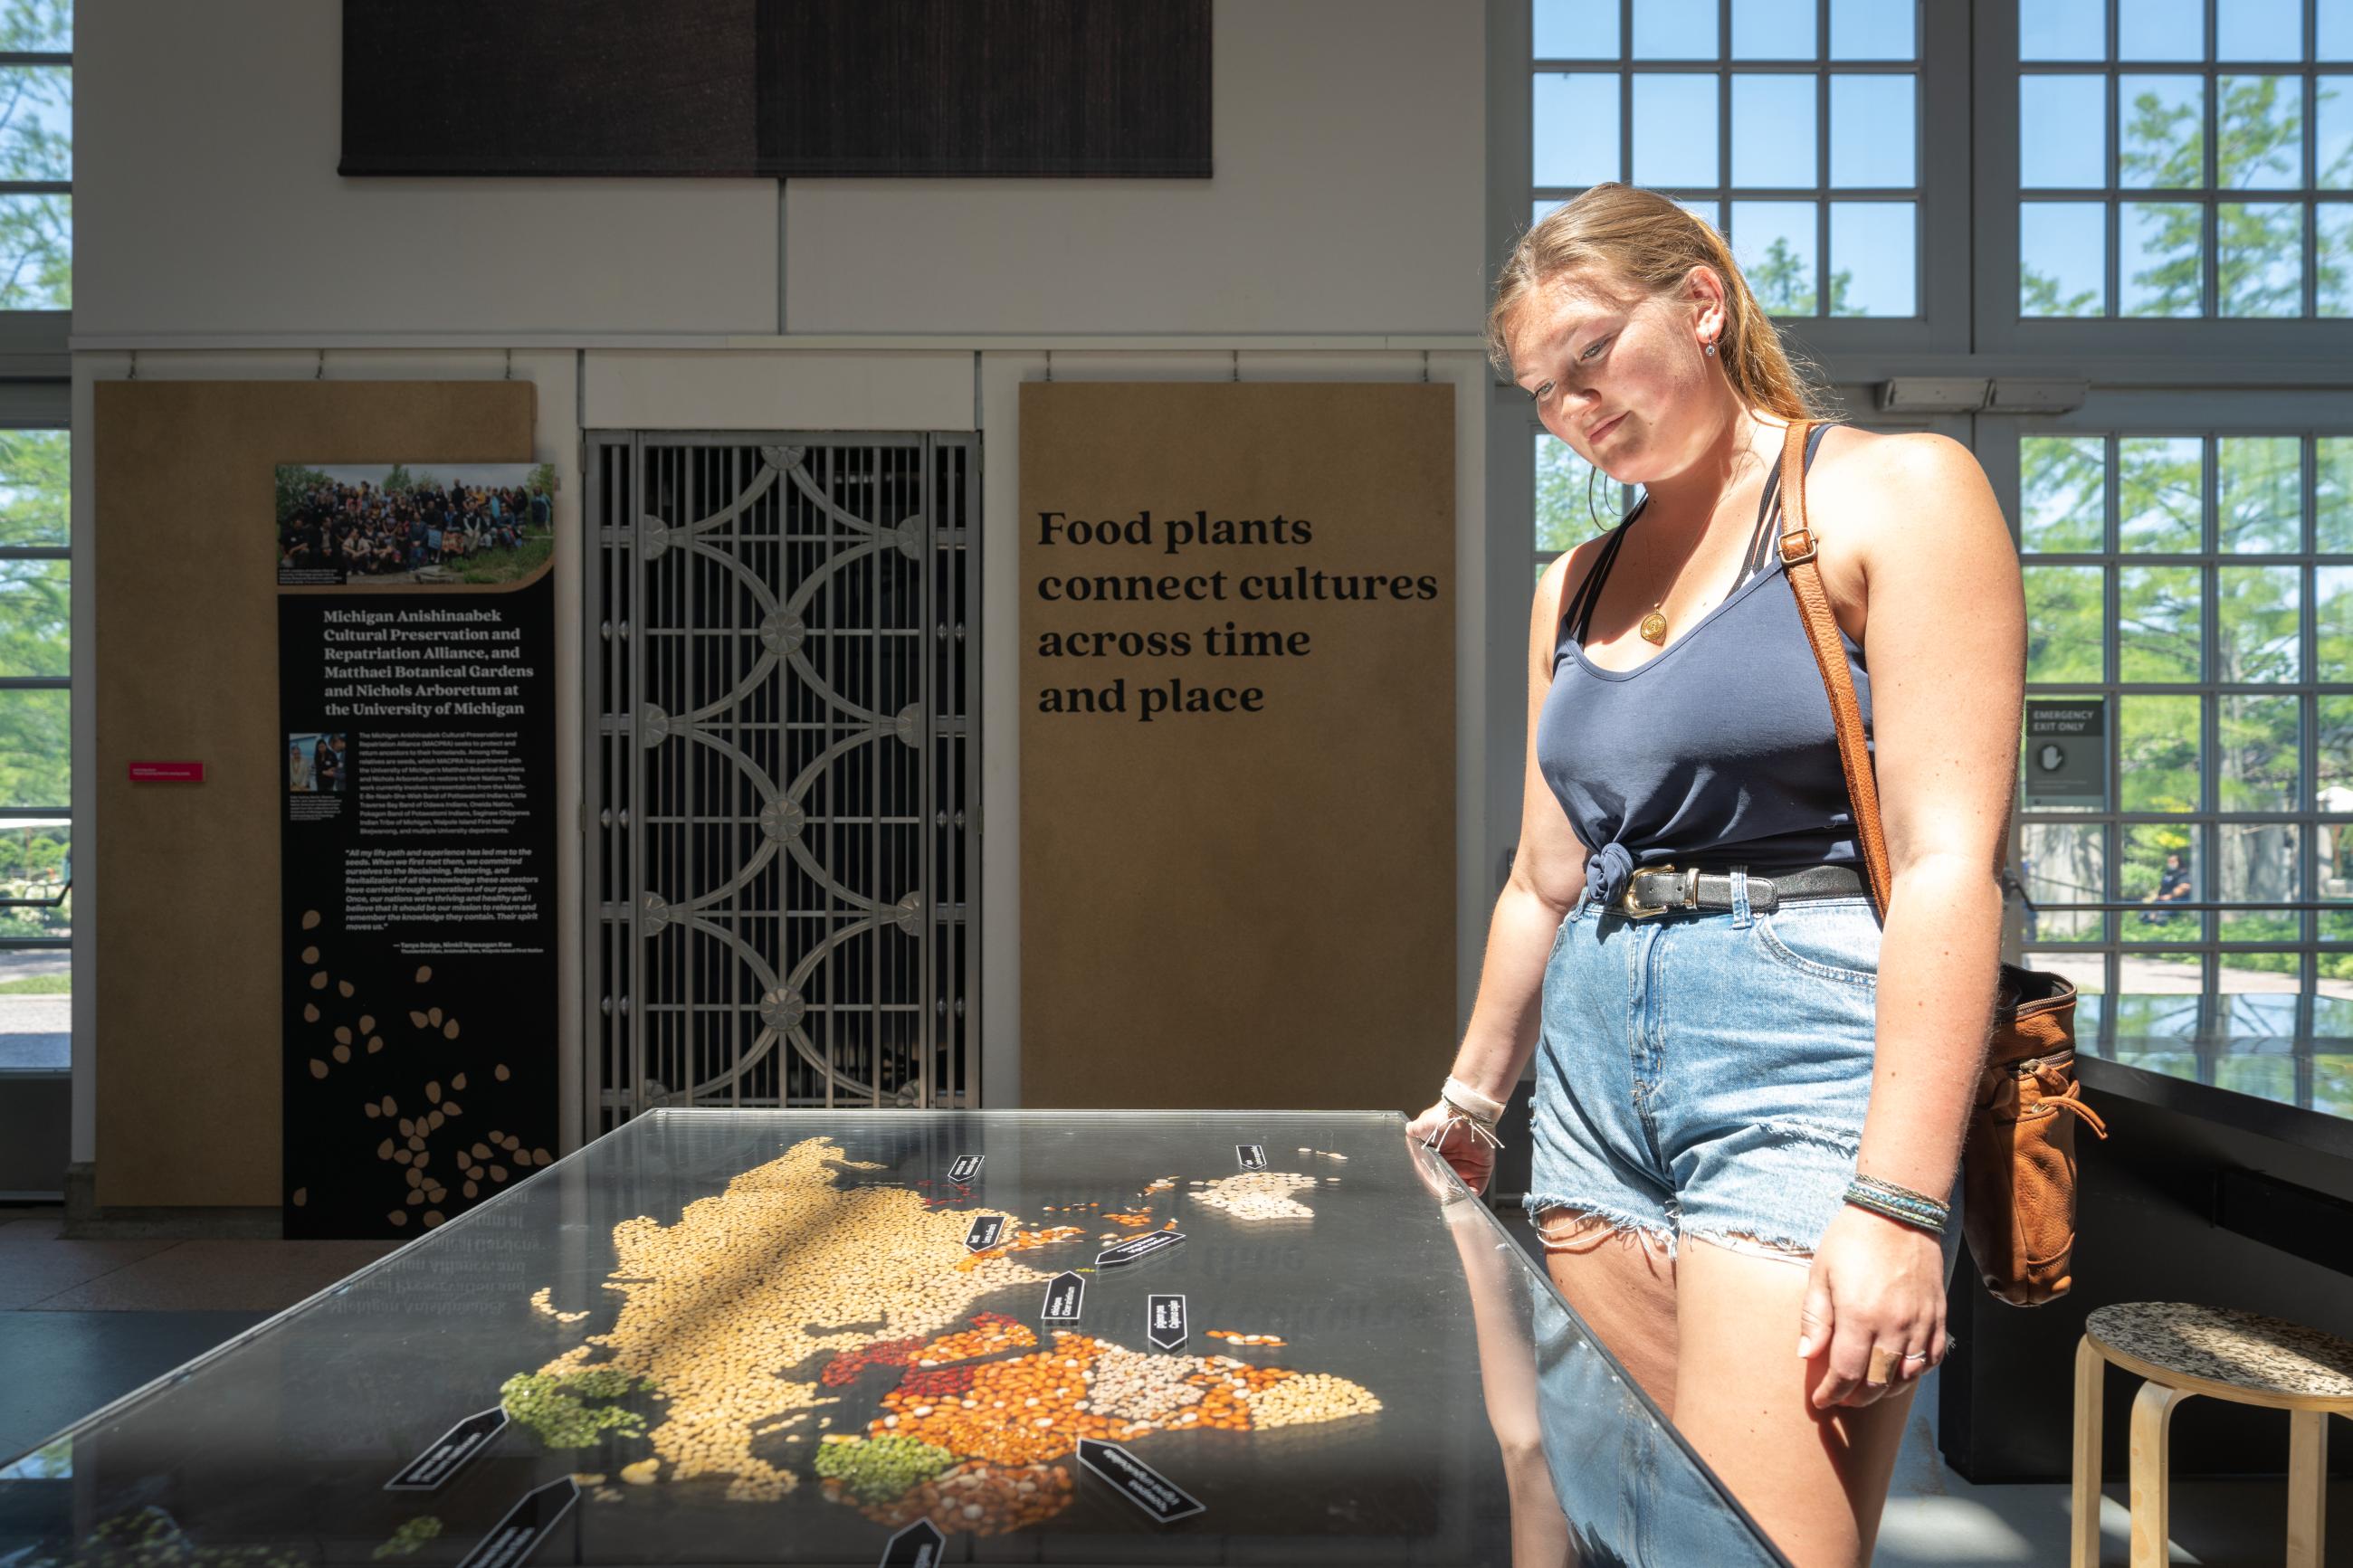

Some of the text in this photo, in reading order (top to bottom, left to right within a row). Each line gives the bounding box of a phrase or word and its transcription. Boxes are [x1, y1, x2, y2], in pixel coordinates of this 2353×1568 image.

[1037, 510, 1312, 554] Food plants
[1038, 566, 1438, 601] connect cultures
[324, 609, 501, 625] Michigan Anishinaabek
[324, 628, 520, 641] Cultural Preservation and
[1038, 622, 1310, 657] across time
[324, 647, 520, 662] Repatriation Alliance, and
[325, 665, 534, 679] Matthaei Botanical Gardens
[325, 684, 519, 698] and Nichols Arboretum at
[1039, 679, 1264, 722] and place
[325, 702, 524, 717] the University of Michigan
[2034, 710, 2094, 719] EMERGENCY
[2034, 722, 2085, 731] EXIT ONLY
[1154, 1305, 1167, 1328] pigeon pea
[1168, 1300, 1181, 1328] Cajanus cajan
